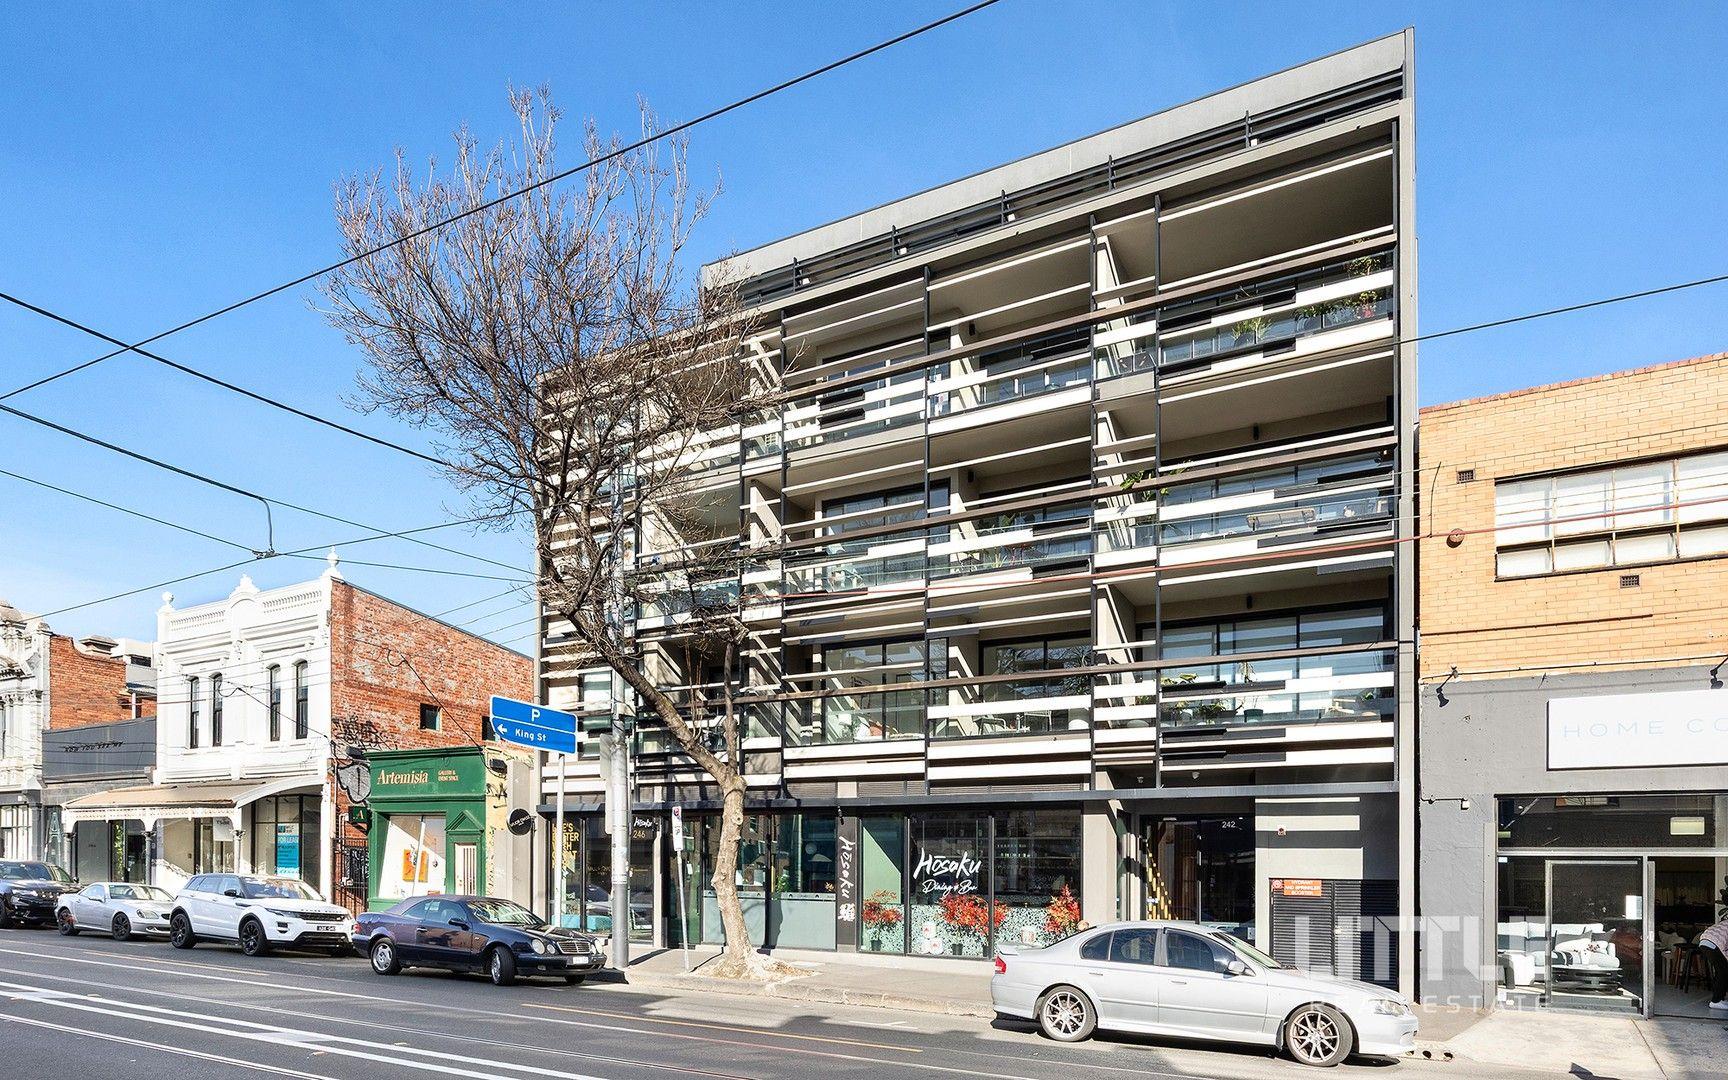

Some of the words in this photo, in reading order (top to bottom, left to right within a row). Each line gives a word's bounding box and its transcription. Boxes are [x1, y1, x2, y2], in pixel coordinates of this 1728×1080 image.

[531, 708, 541, 722] P
[515, 728, 534, 741] King
[537, 733, 547, 742] St
[1563, 720, 1664, 738] HOME
[377, 769, 428, 785] Artemisia
[1222, 821, 1236, 829] 242
[633, 830, 646, 839] 246
